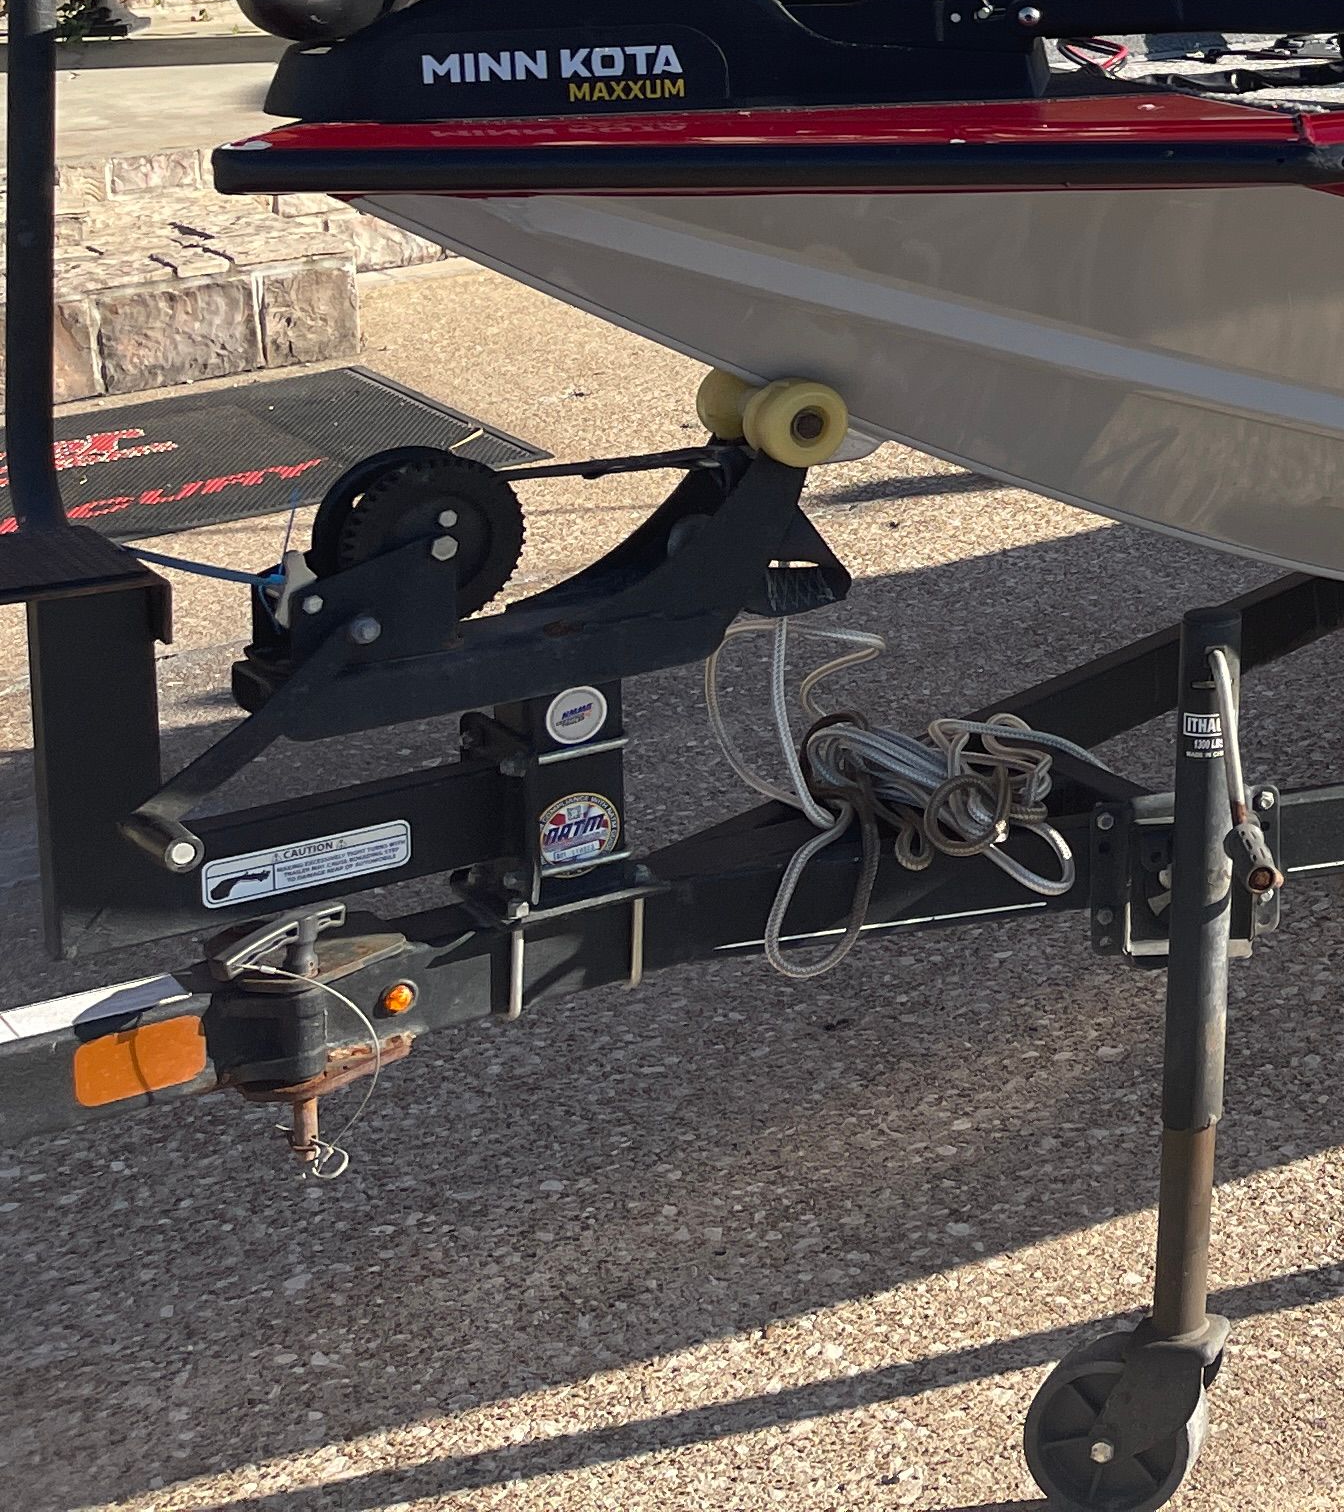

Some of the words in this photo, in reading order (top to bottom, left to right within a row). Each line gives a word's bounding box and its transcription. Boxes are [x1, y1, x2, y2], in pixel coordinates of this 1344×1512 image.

[421, 49, 549, 85] MINN
[559, 44, 684, 79] KOTA
[568, 78, 685, 103] MAXXUM
[283, 841, 334, 860] CAUTION
